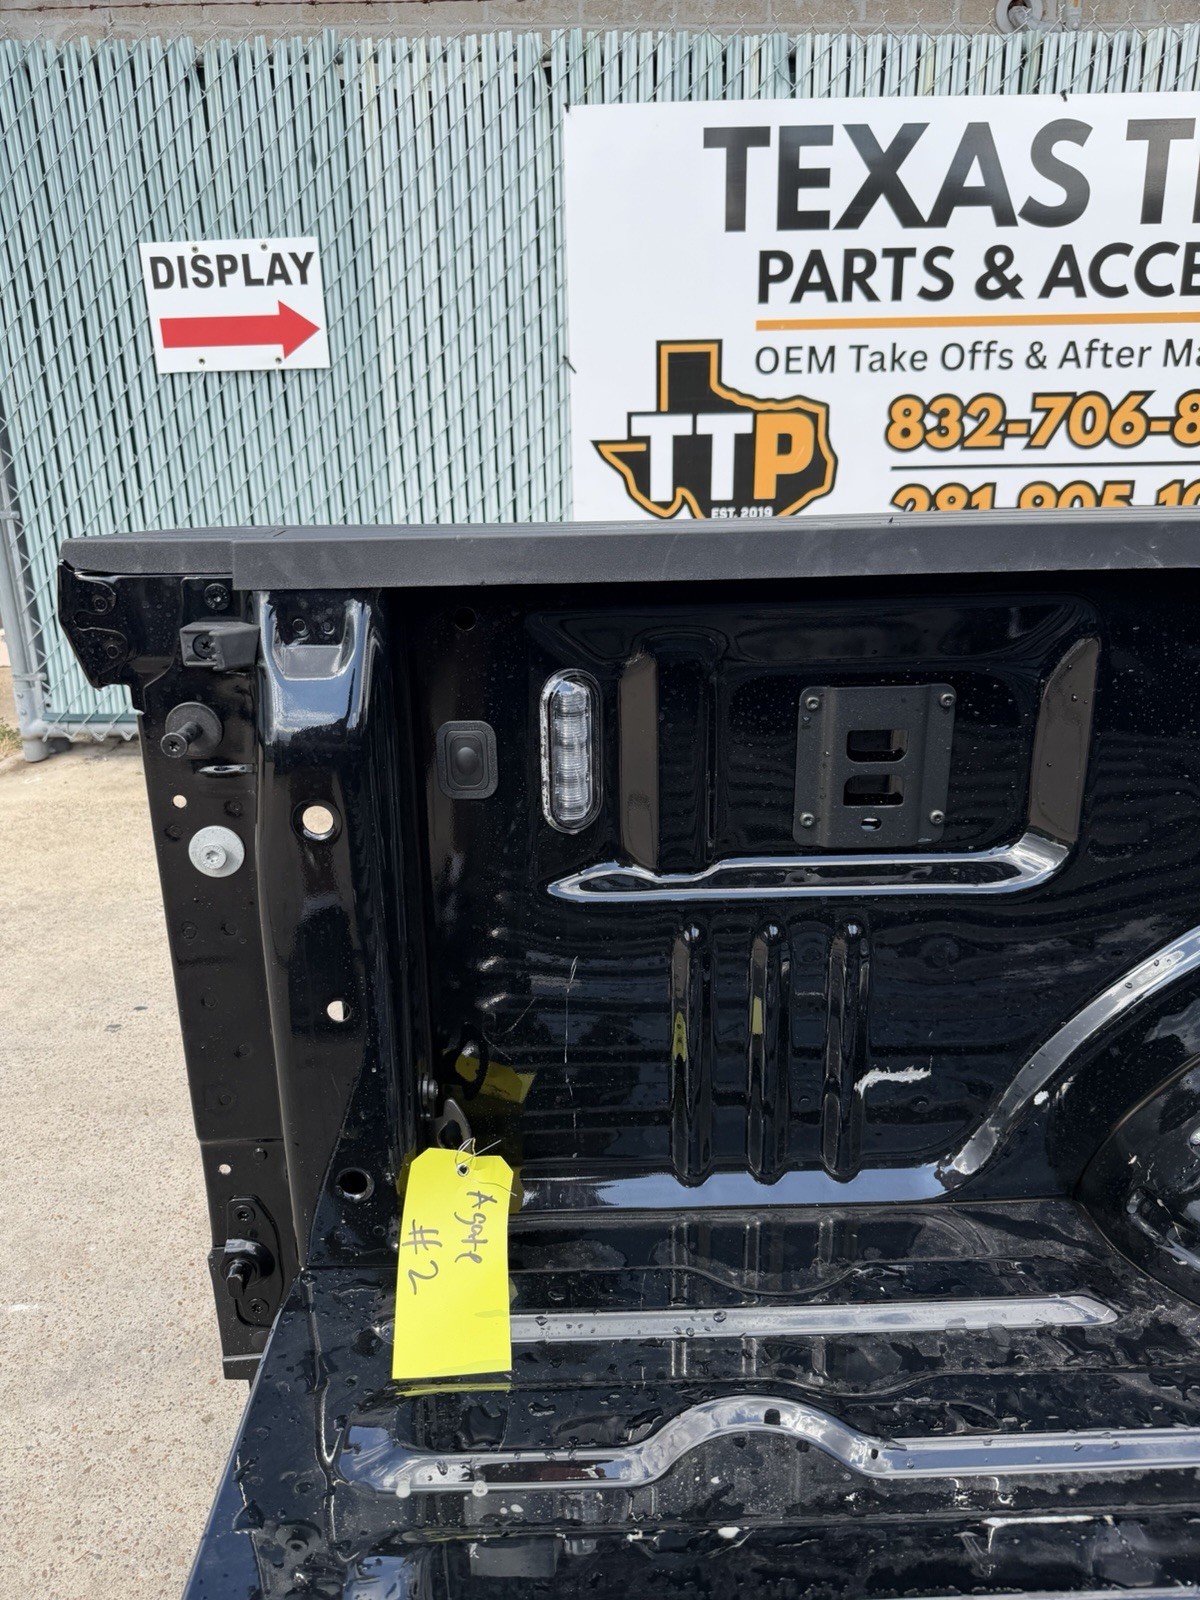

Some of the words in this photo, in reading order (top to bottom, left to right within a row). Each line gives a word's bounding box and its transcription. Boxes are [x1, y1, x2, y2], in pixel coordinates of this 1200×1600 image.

[703, 118, 1094, 232] TEXAS
[1126, 118, 1200, 225] T
[150, 252, 315, 290] DISPLAY
[758, 246, 955, 304] PARTS
[974, 243, 1025, 301] &
[755, 345, 836, 375] OEM
[848, 343, 929, 374] Take
[940, 340, 1014, 373] Offs
[1025, 340, 1048, 371] &
[1058, 338, 1152, 370] After
[631, 413, 815, 503] TTP
[711, 506, 739, 519] EST.
[740, 505, 774, 519] 2019
[402, 1219, 443, 1296] #2
[454, 1190, 498, 1265] Agate
